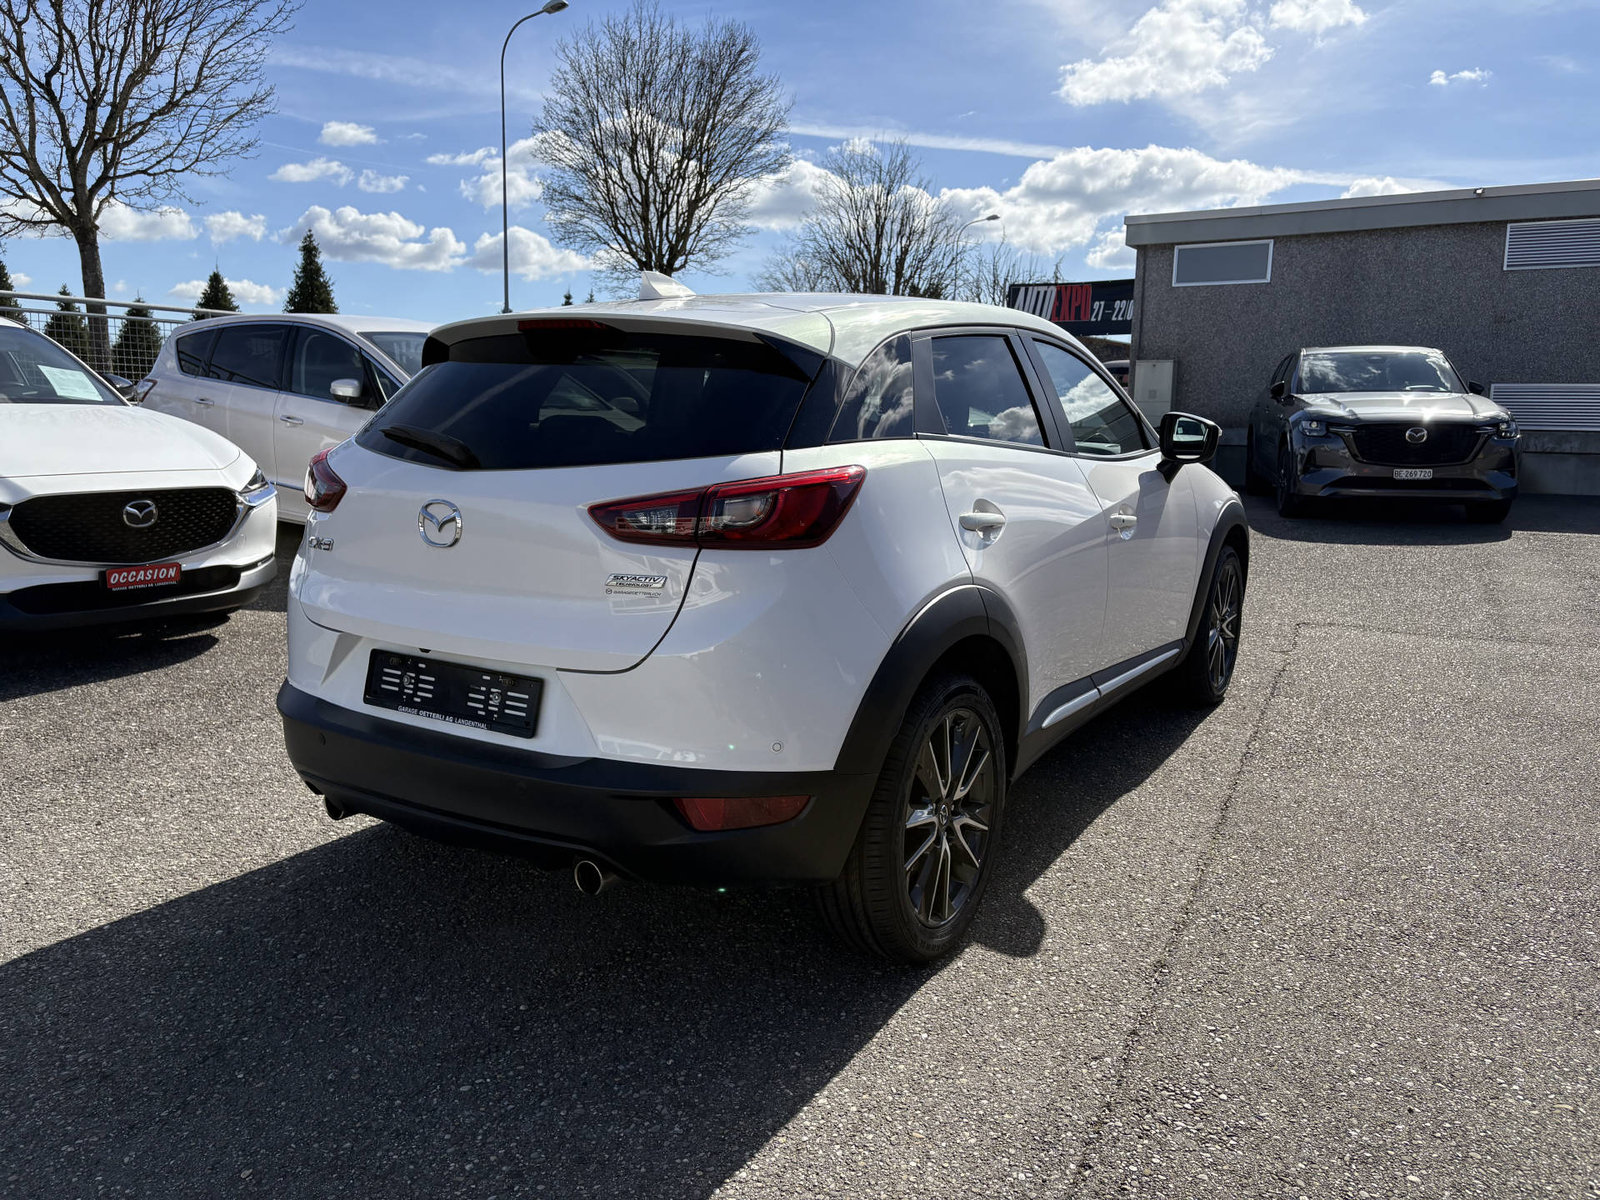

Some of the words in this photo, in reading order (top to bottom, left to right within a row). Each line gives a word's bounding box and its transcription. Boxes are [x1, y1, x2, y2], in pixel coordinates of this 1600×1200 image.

[110, 566, 177, 584] OCCASION
[397, 705, 418, 715] GARAGE
[418, 710, 445, 721] OETTERLI
[454, 718, 488, 730] LANGENTHAL
